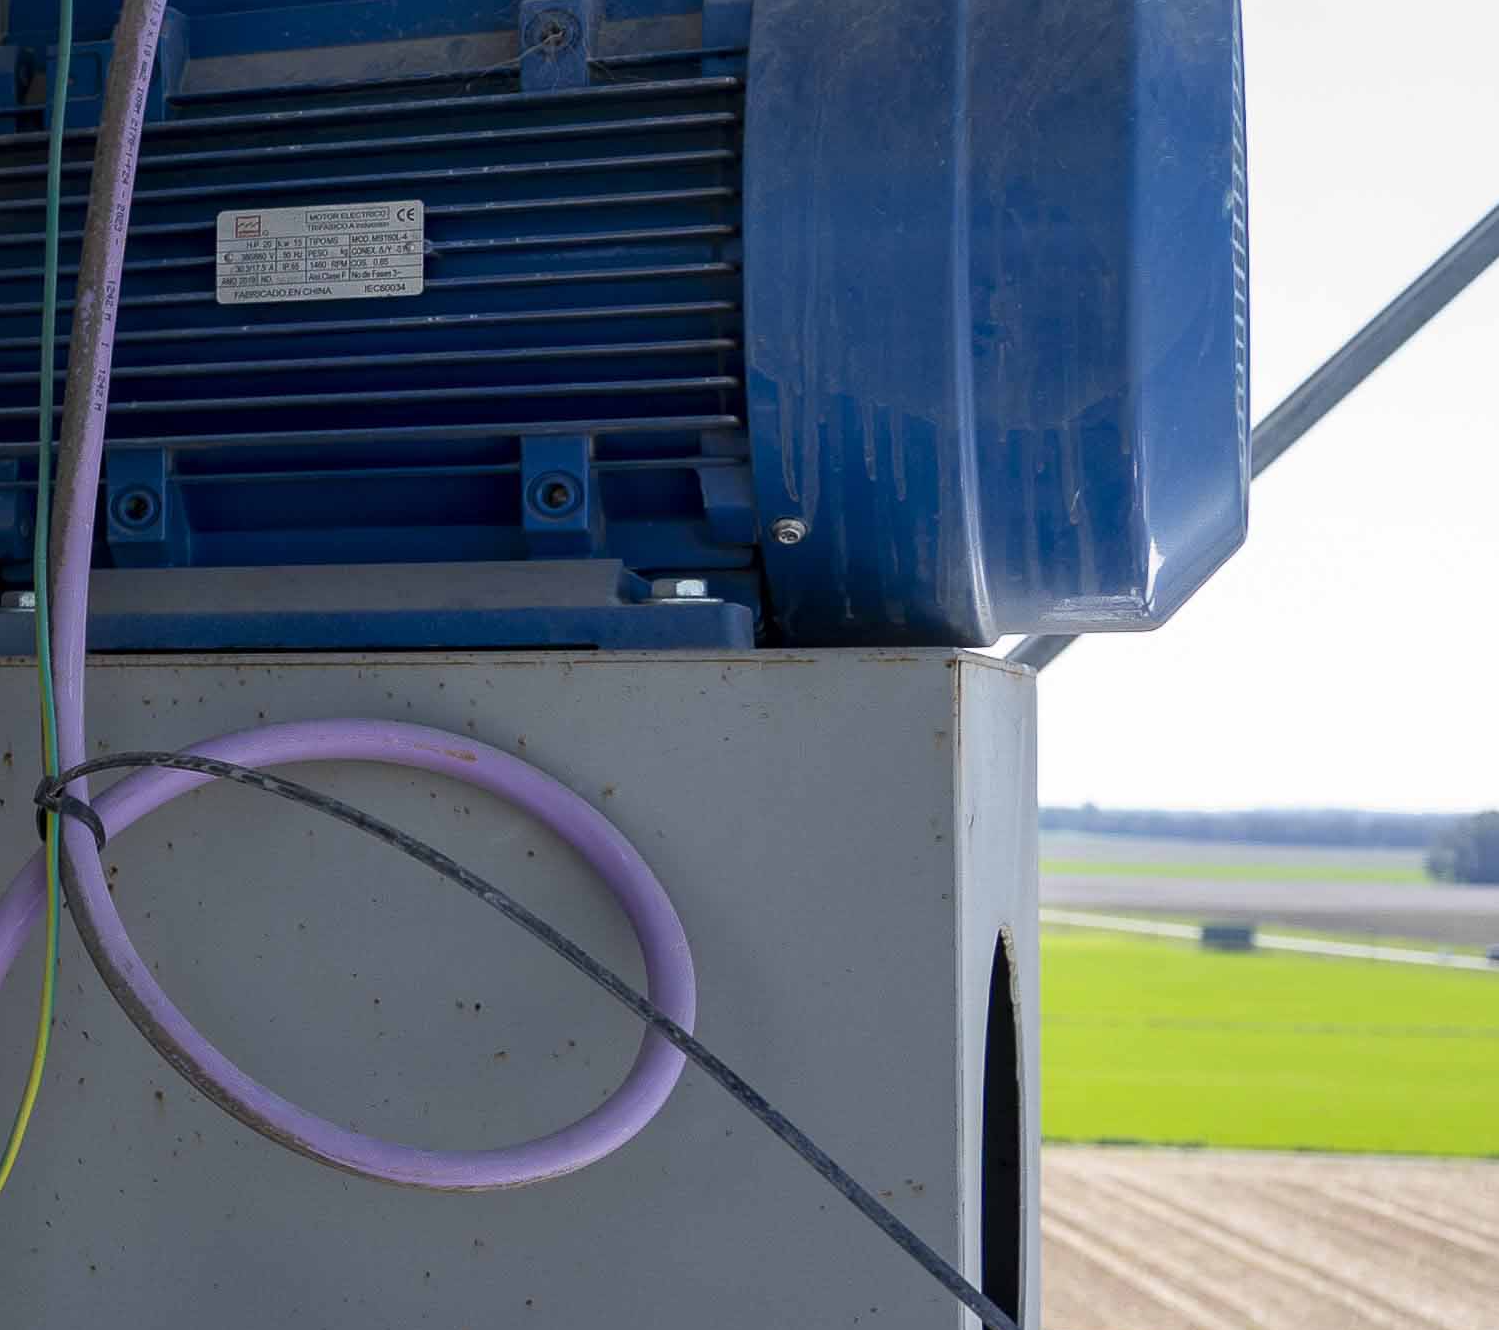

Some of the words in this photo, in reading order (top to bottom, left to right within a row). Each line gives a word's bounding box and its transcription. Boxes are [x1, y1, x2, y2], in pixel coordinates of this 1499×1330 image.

[309, 213, 339, 221] MOTOR
[287, 288, 302, 296] EN
[302, 286, 333, 296] CHINA
[95, 368, 106, 399] 1242
